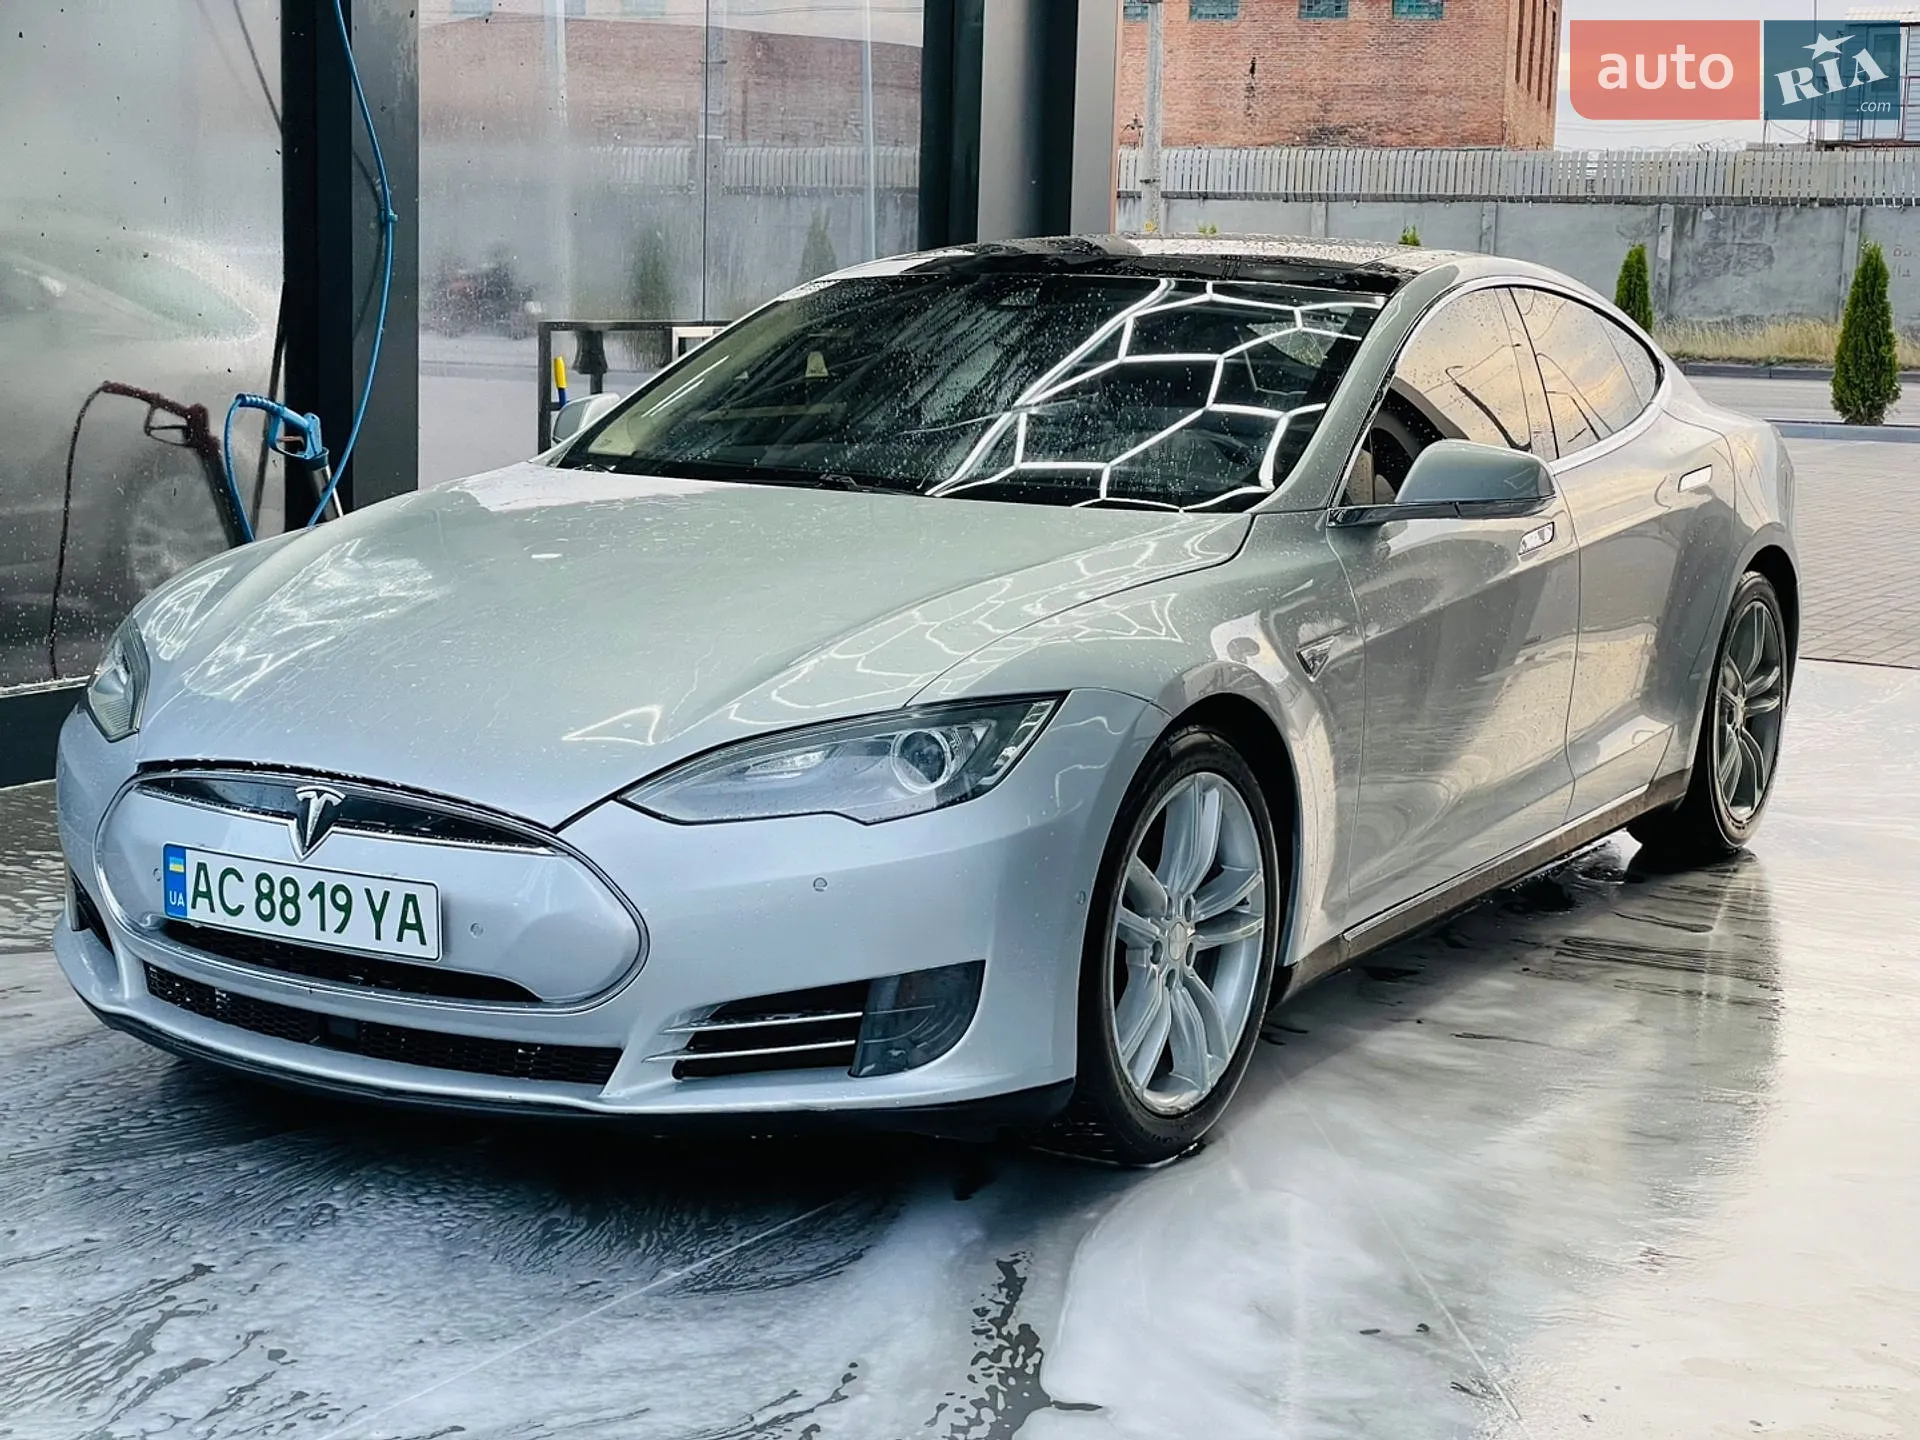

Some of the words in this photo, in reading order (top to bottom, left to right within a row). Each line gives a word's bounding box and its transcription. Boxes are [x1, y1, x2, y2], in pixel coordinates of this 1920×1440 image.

[169, 890, 185, 908] UA
[190, 861, 245, 917] AC
[254, 871, 352, 935] 8819
[364, 887, 427, 946] YA
